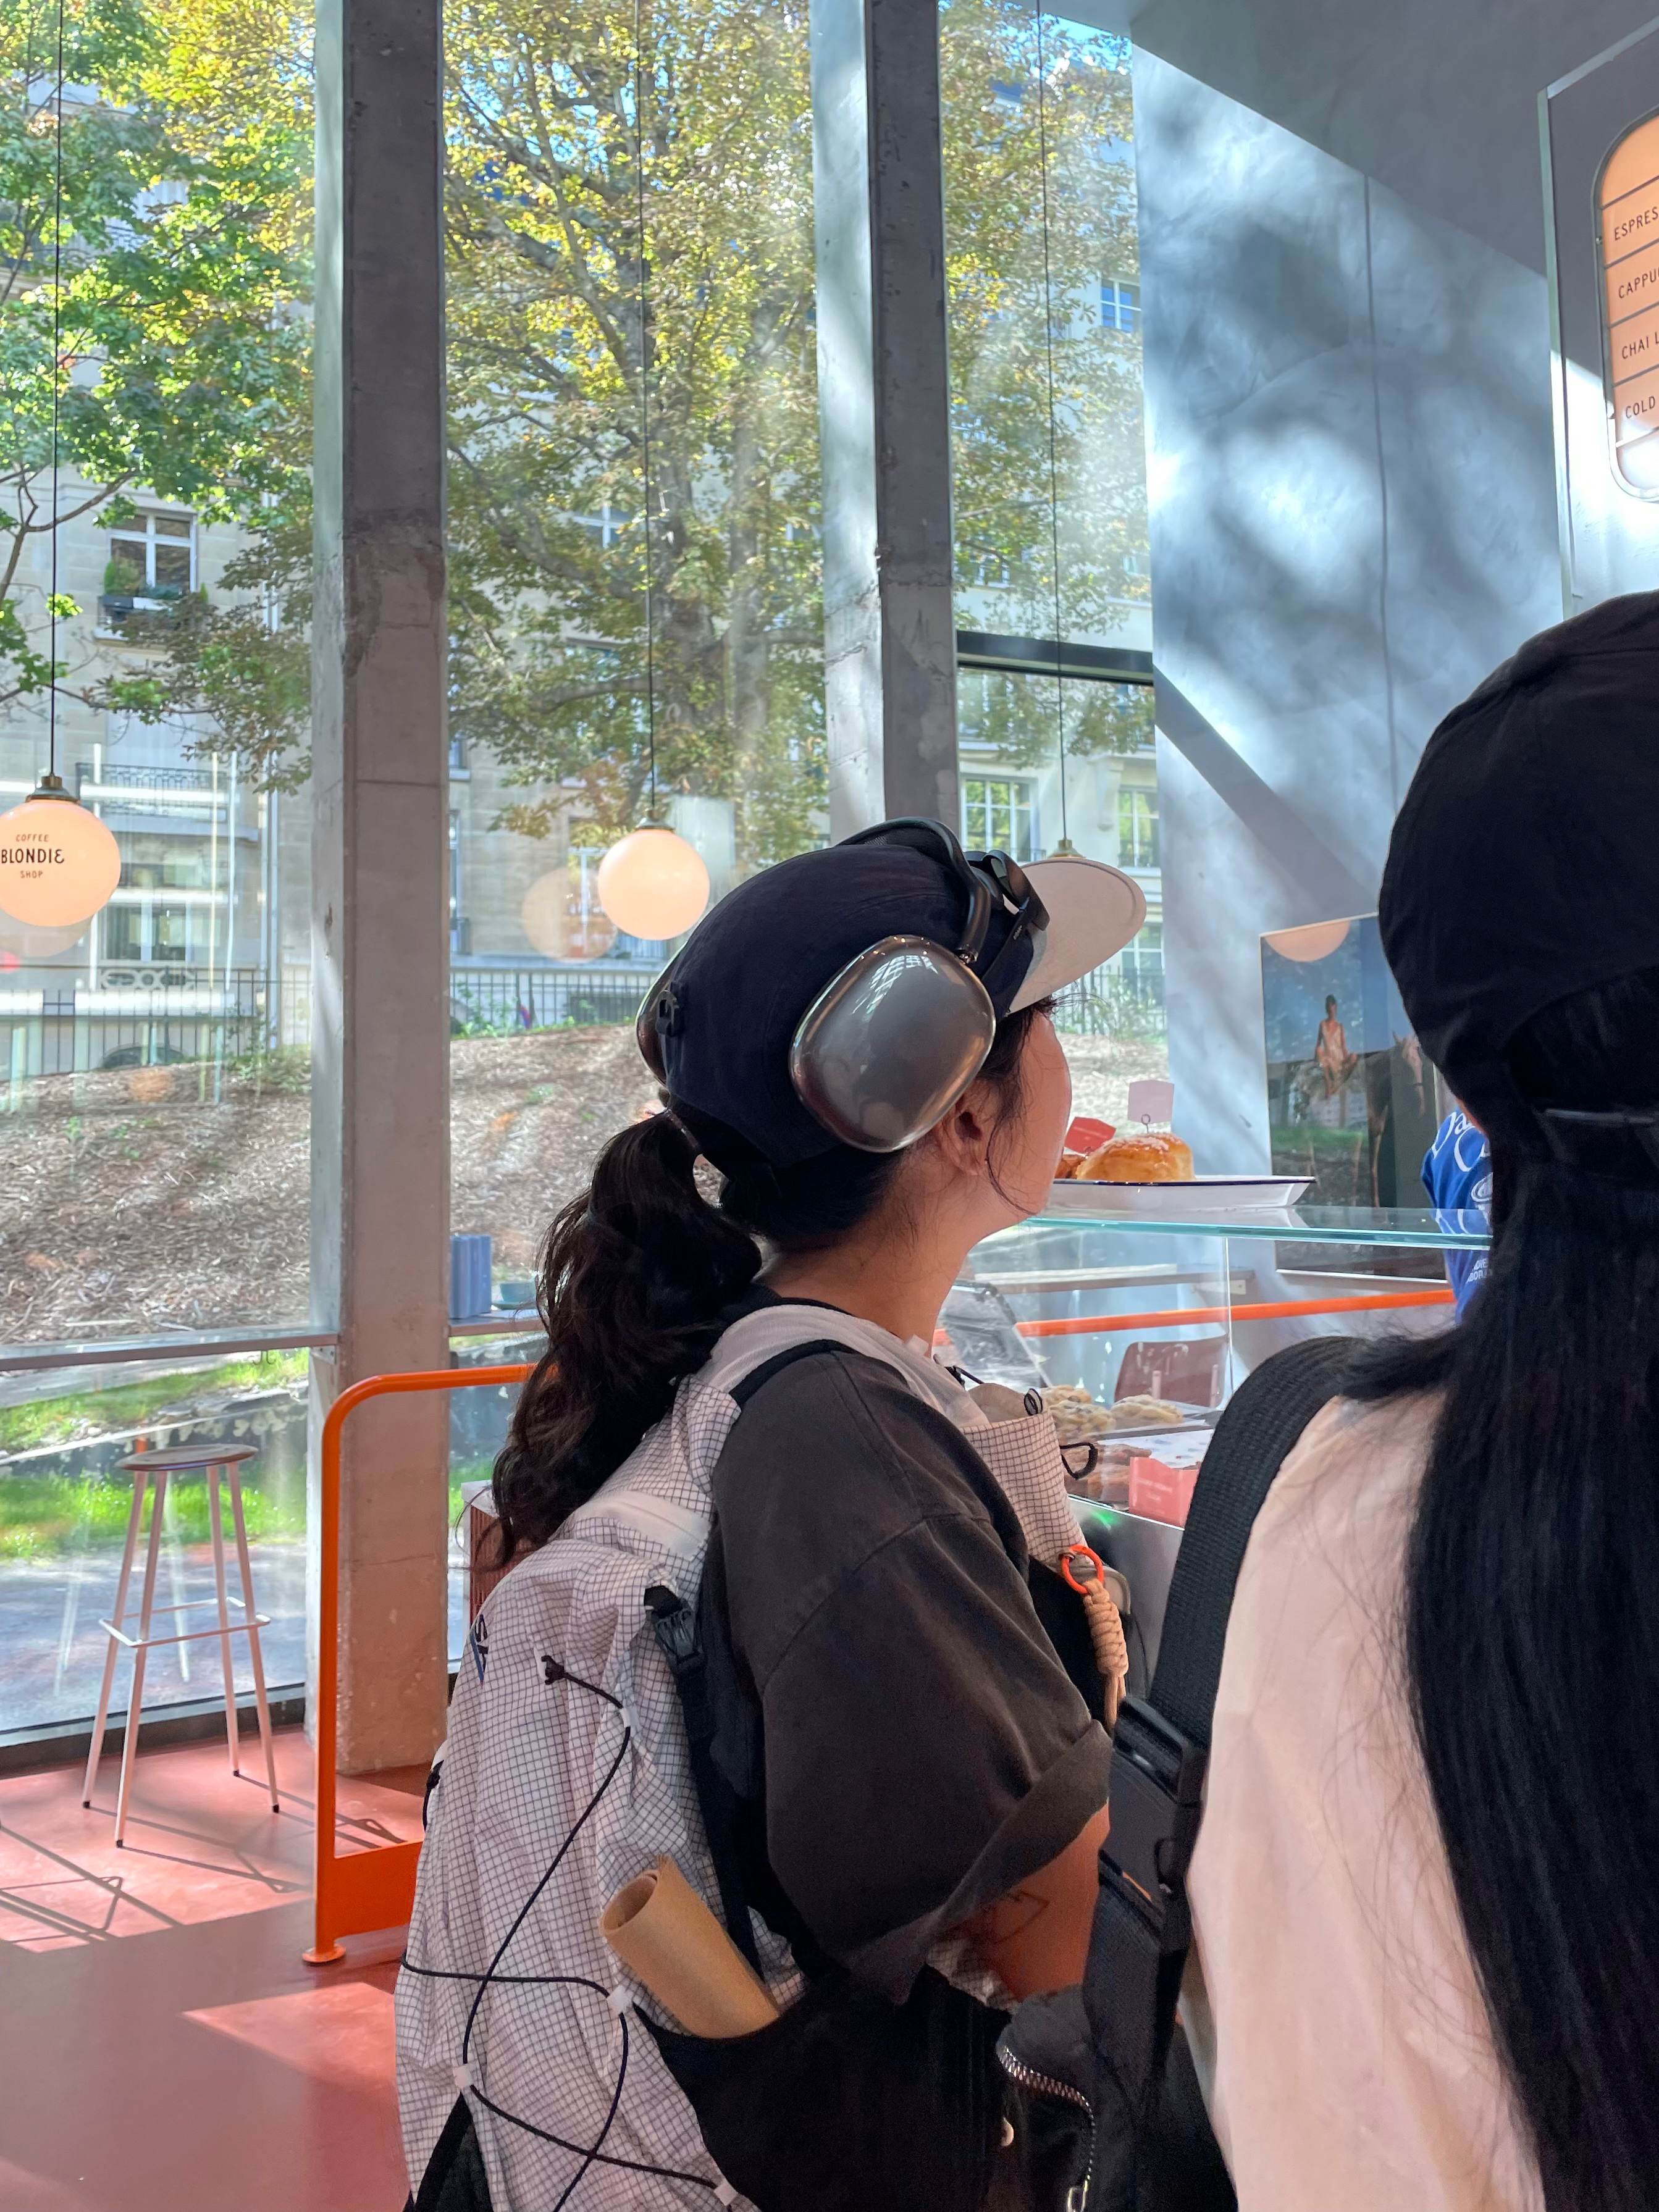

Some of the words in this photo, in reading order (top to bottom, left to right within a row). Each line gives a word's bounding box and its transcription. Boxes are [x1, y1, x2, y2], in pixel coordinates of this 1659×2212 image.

[1618, 267, 1659, 299] CAPPU
[1622, 335, 1648, 359] CHAI
[1626, 396, 1655, 419] COLD
[15, 834, 49, 842] COFFEE
[1, 848, 65, 863] BLONDIE
[20, 870, 43, 879] SHOP
